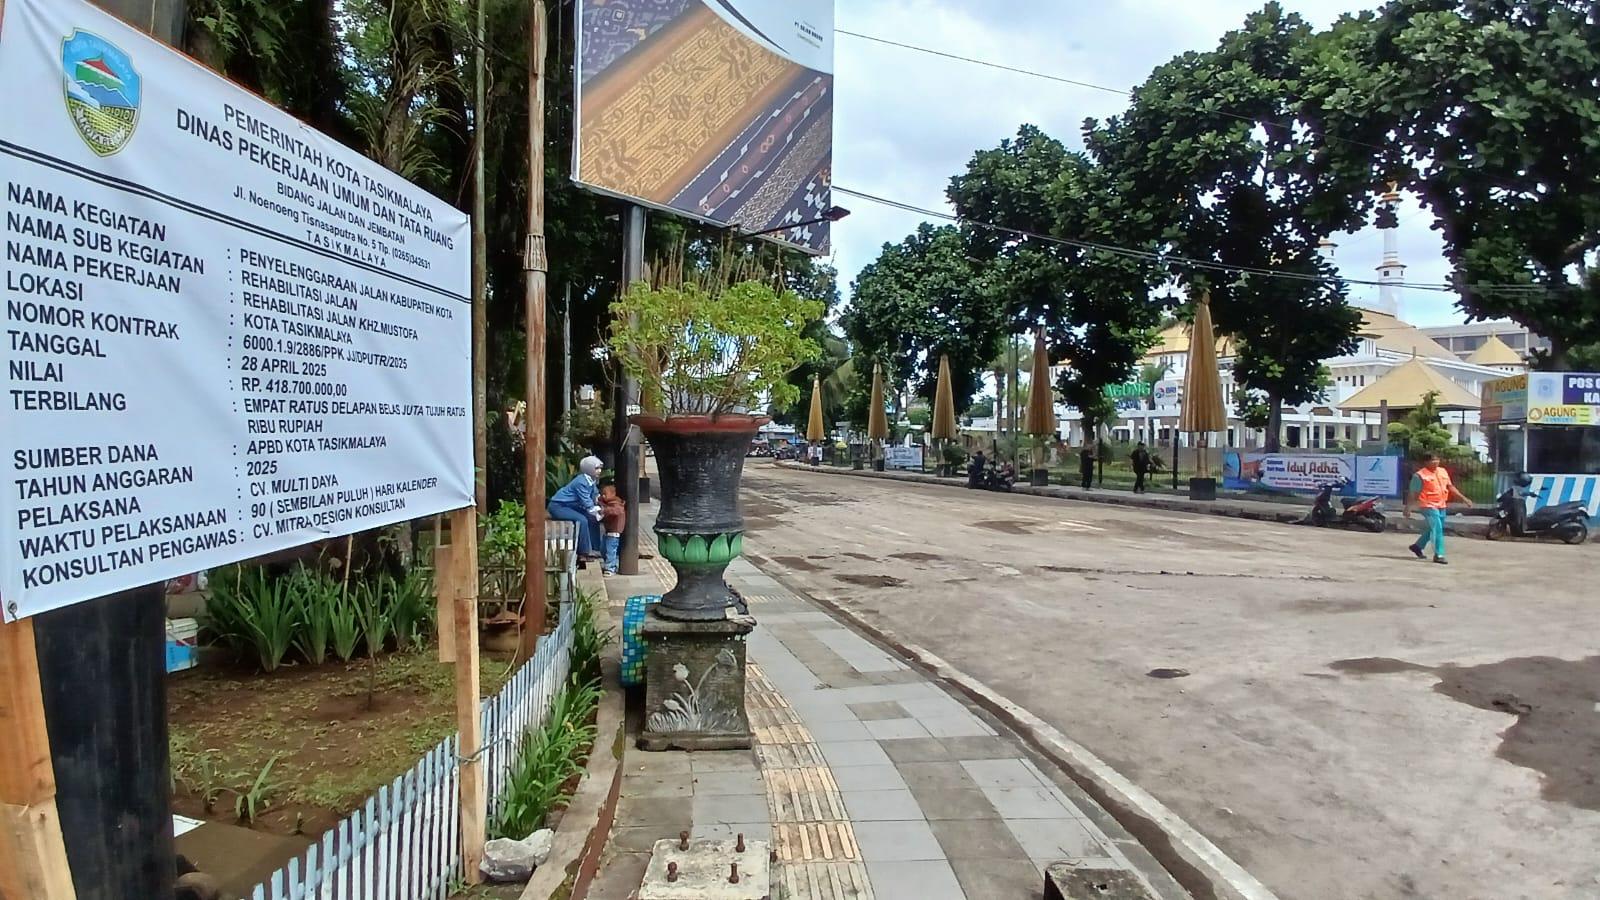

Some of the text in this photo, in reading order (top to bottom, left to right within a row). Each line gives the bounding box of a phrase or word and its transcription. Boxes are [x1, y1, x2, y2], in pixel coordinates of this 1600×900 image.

[177, 108, 454, 250] DINAS PEKERJAAN UMUM DAN TATA RUANG
[224, 104, 433, 222] PEMERINTAH KOTA TASIKMALAYA
[8, 182, 166, 241] NAMA KEGIATAN
[277, 181, 405, 245] BIDANG JALAN DAN JEMBATAN
[7, 211, 204, 274] NAMA SUB KEGIATAN
[249, 190, 299, 223] Noenoeng
[301, 211, 356, 242] Tisnasaputra
[357, 233, 369, 247] No.
[371, 240, 377, 250] 5
[377, 241, 391, 256] Tlp.
[392, 246, 431, 270] (0265)342631
[306, 230, 386, 268] TASIKMALAYA
[7, 241, 180, 294] NAMA PEKERJAAN
[240, 248, 453, 320] PENYELENGGARAAN JALAN KABUPATEN KOTA
[7, 270, 83, 301] LOKASI
[241, 270, 358, 311] REHABILITASI JALAN
[7, 300, 180, 340] NOMOR KONTRAK
[243, 291, 324, 321] REHABILITASI
[326, 308, 356, 328] JALAN
[7, 330, 106, 358] TANGGAL
[244, 313, 353, 345] KOTA TASIKMALAYA
[243, 334, 345, 361] 6000.1.9/2886/PPK
[9, 360, 64, 382] NILAI
[241, 356, 327, 377] 28 APRIL 2025
[1568, 377, 1593, 389] POS
[10, 389, 127, 411] TERBILANG
[242, 377, 347, 398] RP. 418.700.000,00
[244, 399, 466, 417] EMPAT RATUS DELAPAN BELAS JUTA TUJUH RATUS
[1543, 407, 1577, 417] AGUNG
[248, 419, 323, 434] RIBU RUPIAH
[14, 444, 158, 470] SUMBER DANA
[247, 436, 387, 455] APBD KOTA TASIKMALAYA
[15, 466, 193, 500] TAHUN ANGGARAN
[246, 461, 278, 476] 2025
[250, 474, 339, 497] CV. MULTI DAYA
[1287, 461, 1307, 476] Idul
[18, 496, 141, 530] PELAKSANA
[251, 503, 266, 518] 90
[277, 493, 334, 514] SEMBILAN
[337, 488, 369, 504] PULUH
[375, 483, 395, 497] HARI
[396, 477, 438, 493] KALENDER
[20, 508, 227, 559] WAKTU PELAKSANAAN
[253, 498, 406, 539] CV. MITRA DESIGN KONSULTAN
[23, 547, 144, 589] KONSULTAN
